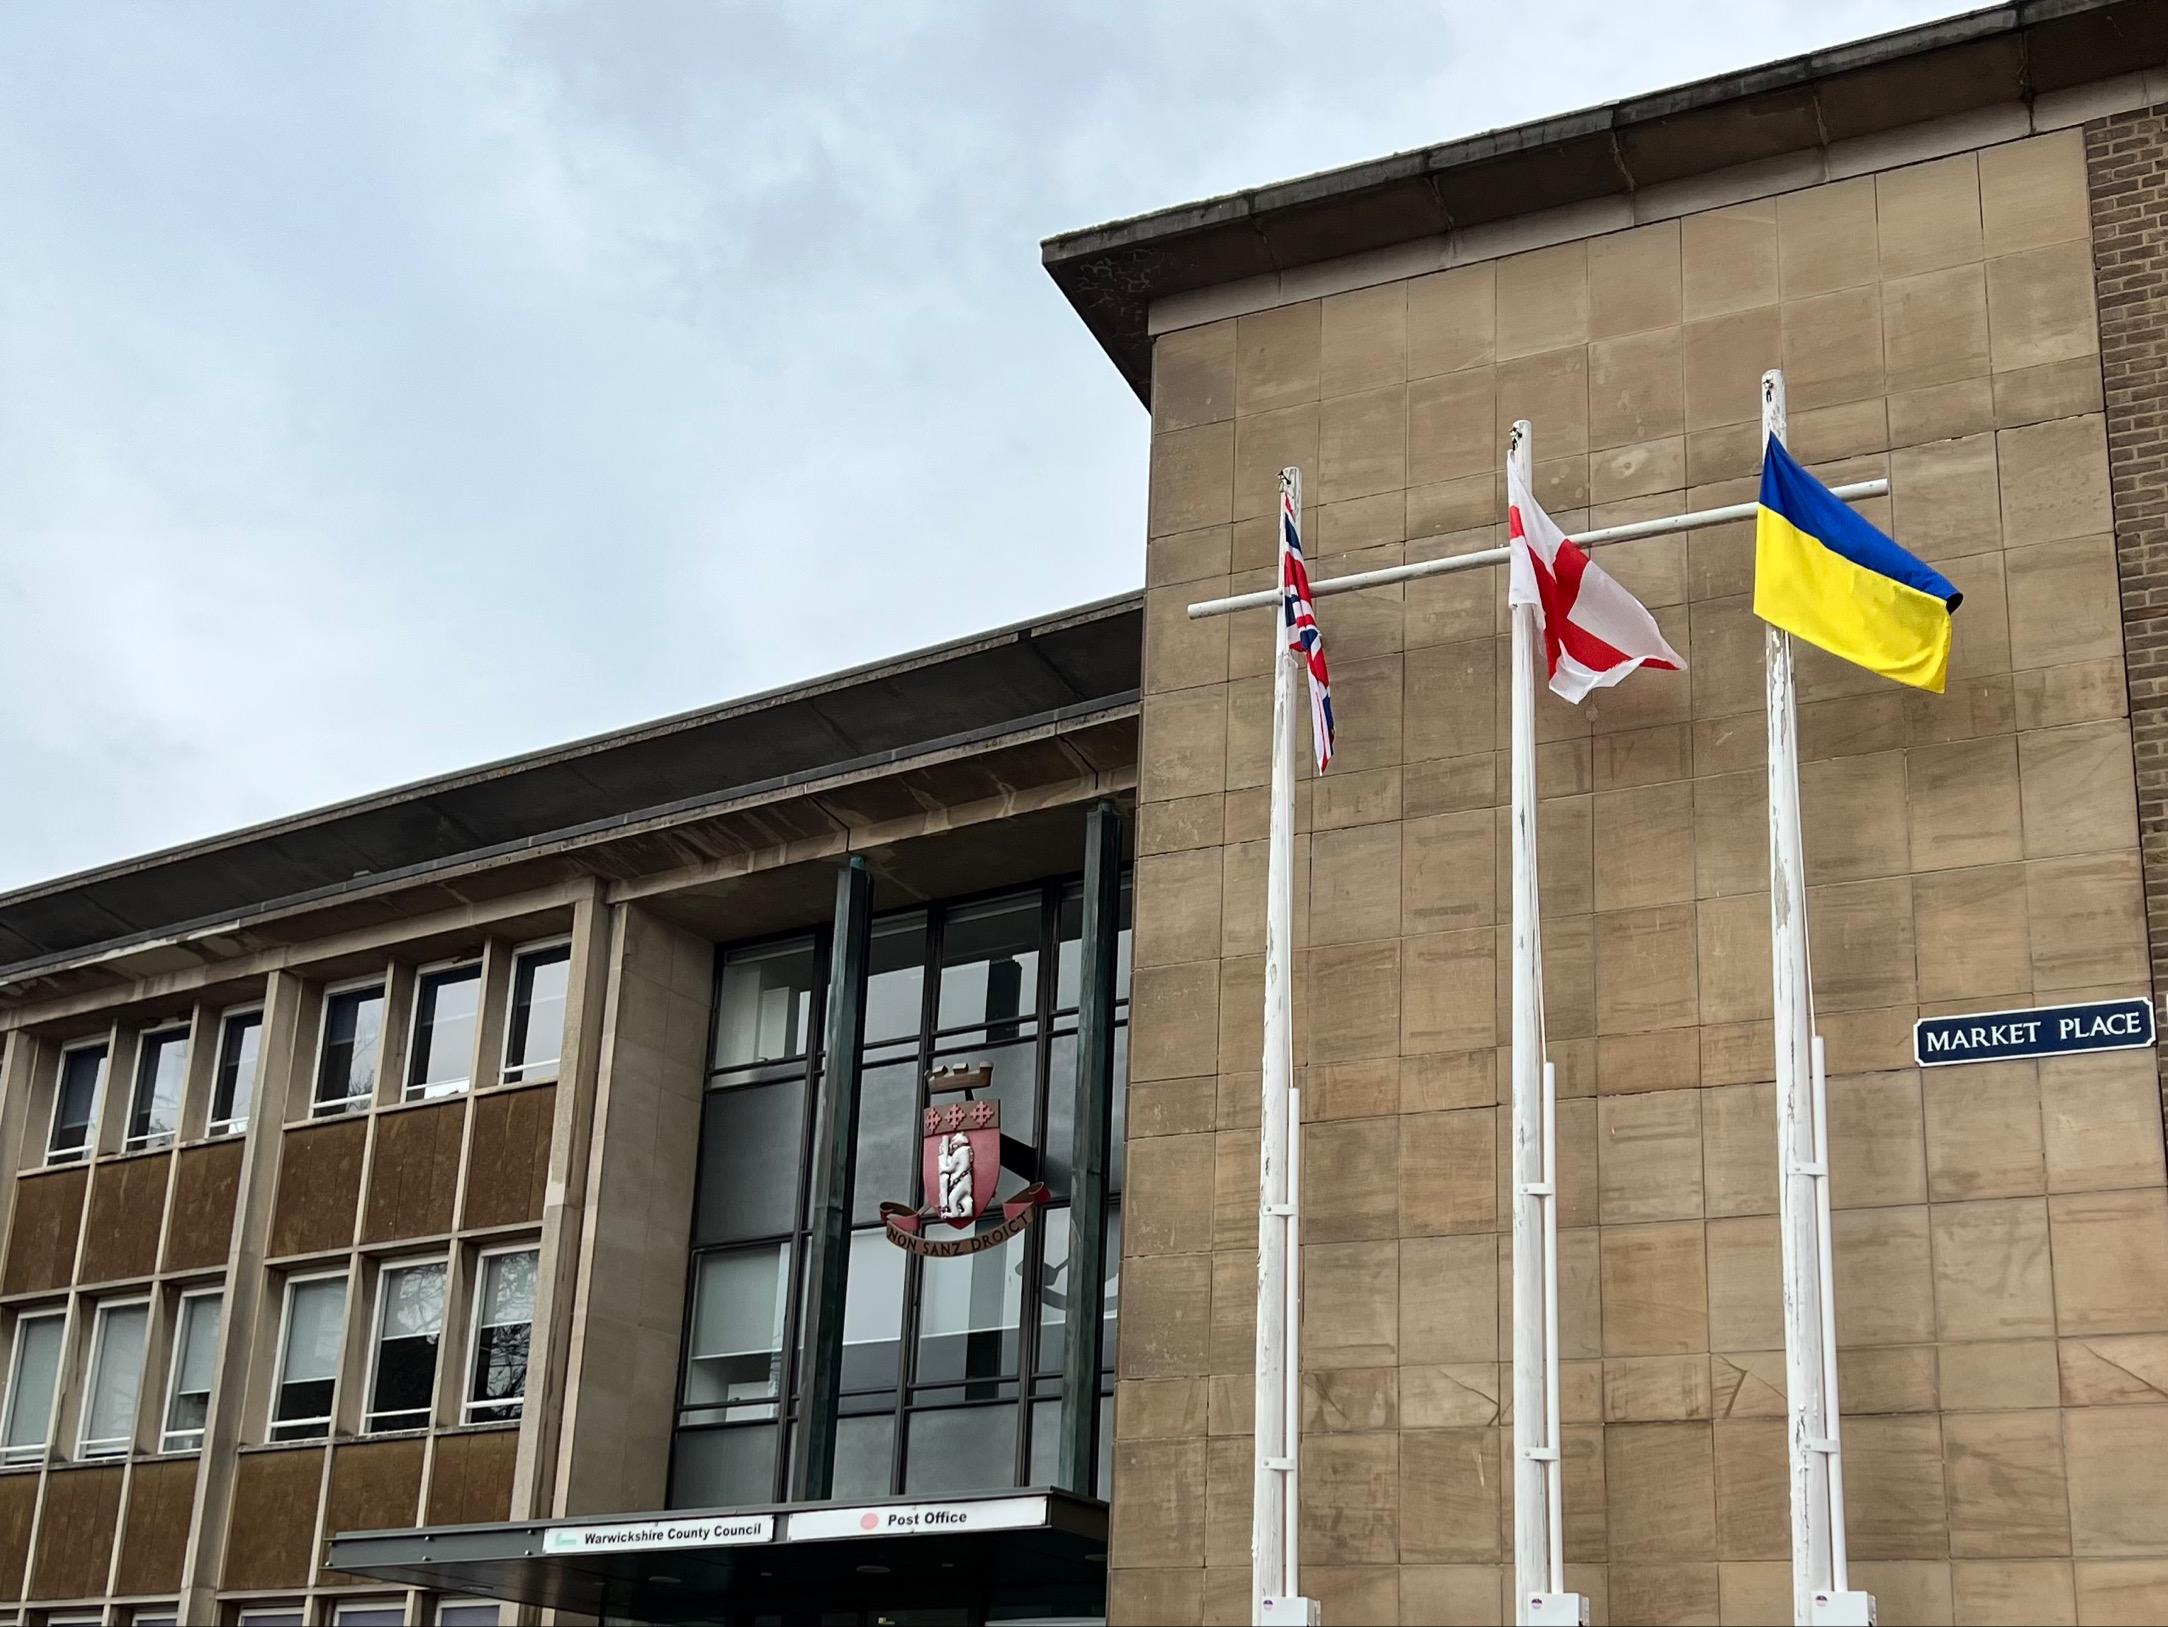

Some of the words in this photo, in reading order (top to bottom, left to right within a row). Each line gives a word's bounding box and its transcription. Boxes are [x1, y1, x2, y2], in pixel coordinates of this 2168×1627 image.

[1926, 1021, 2041, 1052] MARKET
[2059, 1011, 2142, 1040] PLACE
[888, 1227, 916, 1250] NON
[923, 1241, 965, 1256] SANZ
[971, 1211, 1028, 1249] DROICT
[585, 1528, 664, 1544] Warwickshire
[667, 1526, 710, 1540] County
[714, 1523, 761, 1537] Council
[888, 1513, 919, 1526] Post
[924, 1510, 967, 1524] Office
